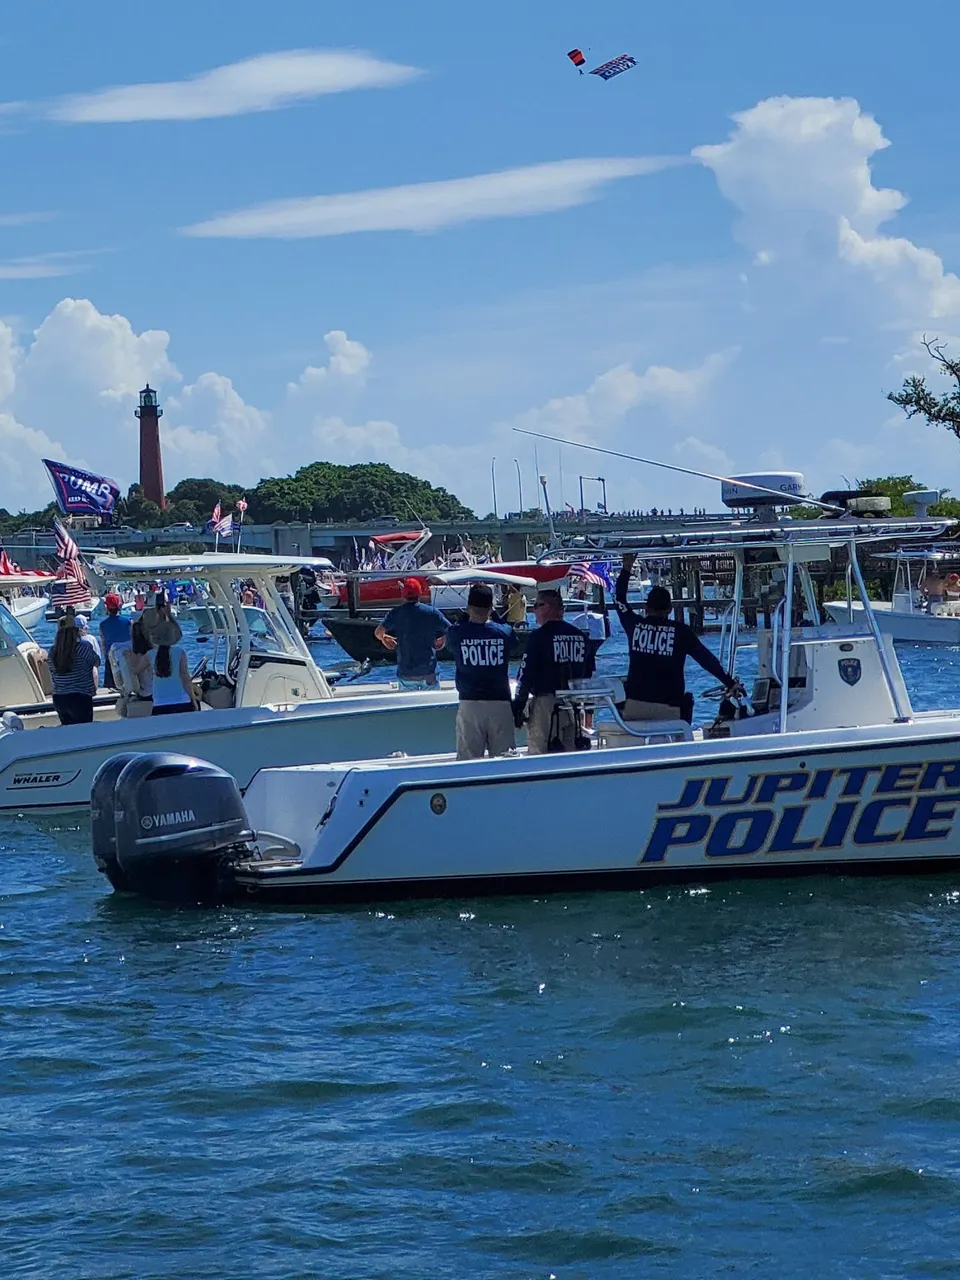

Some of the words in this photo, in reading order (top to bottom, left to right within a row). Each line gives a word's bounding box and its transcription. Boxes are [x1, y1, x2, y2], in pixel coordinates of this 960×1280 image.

[636, 623, 676, 633] JUPITER
[632, 627, 675, 652] POLICE
[461, 646, 504, 666] POLICE
[553, 641, 585, 662] POLICE
[13, 775, 60, 784] WHALER
[656, 759, 960, 811] JUPITER
[153, 809, 196, 827] YAMAHA
[637, 793, 960, 865] POLICE
